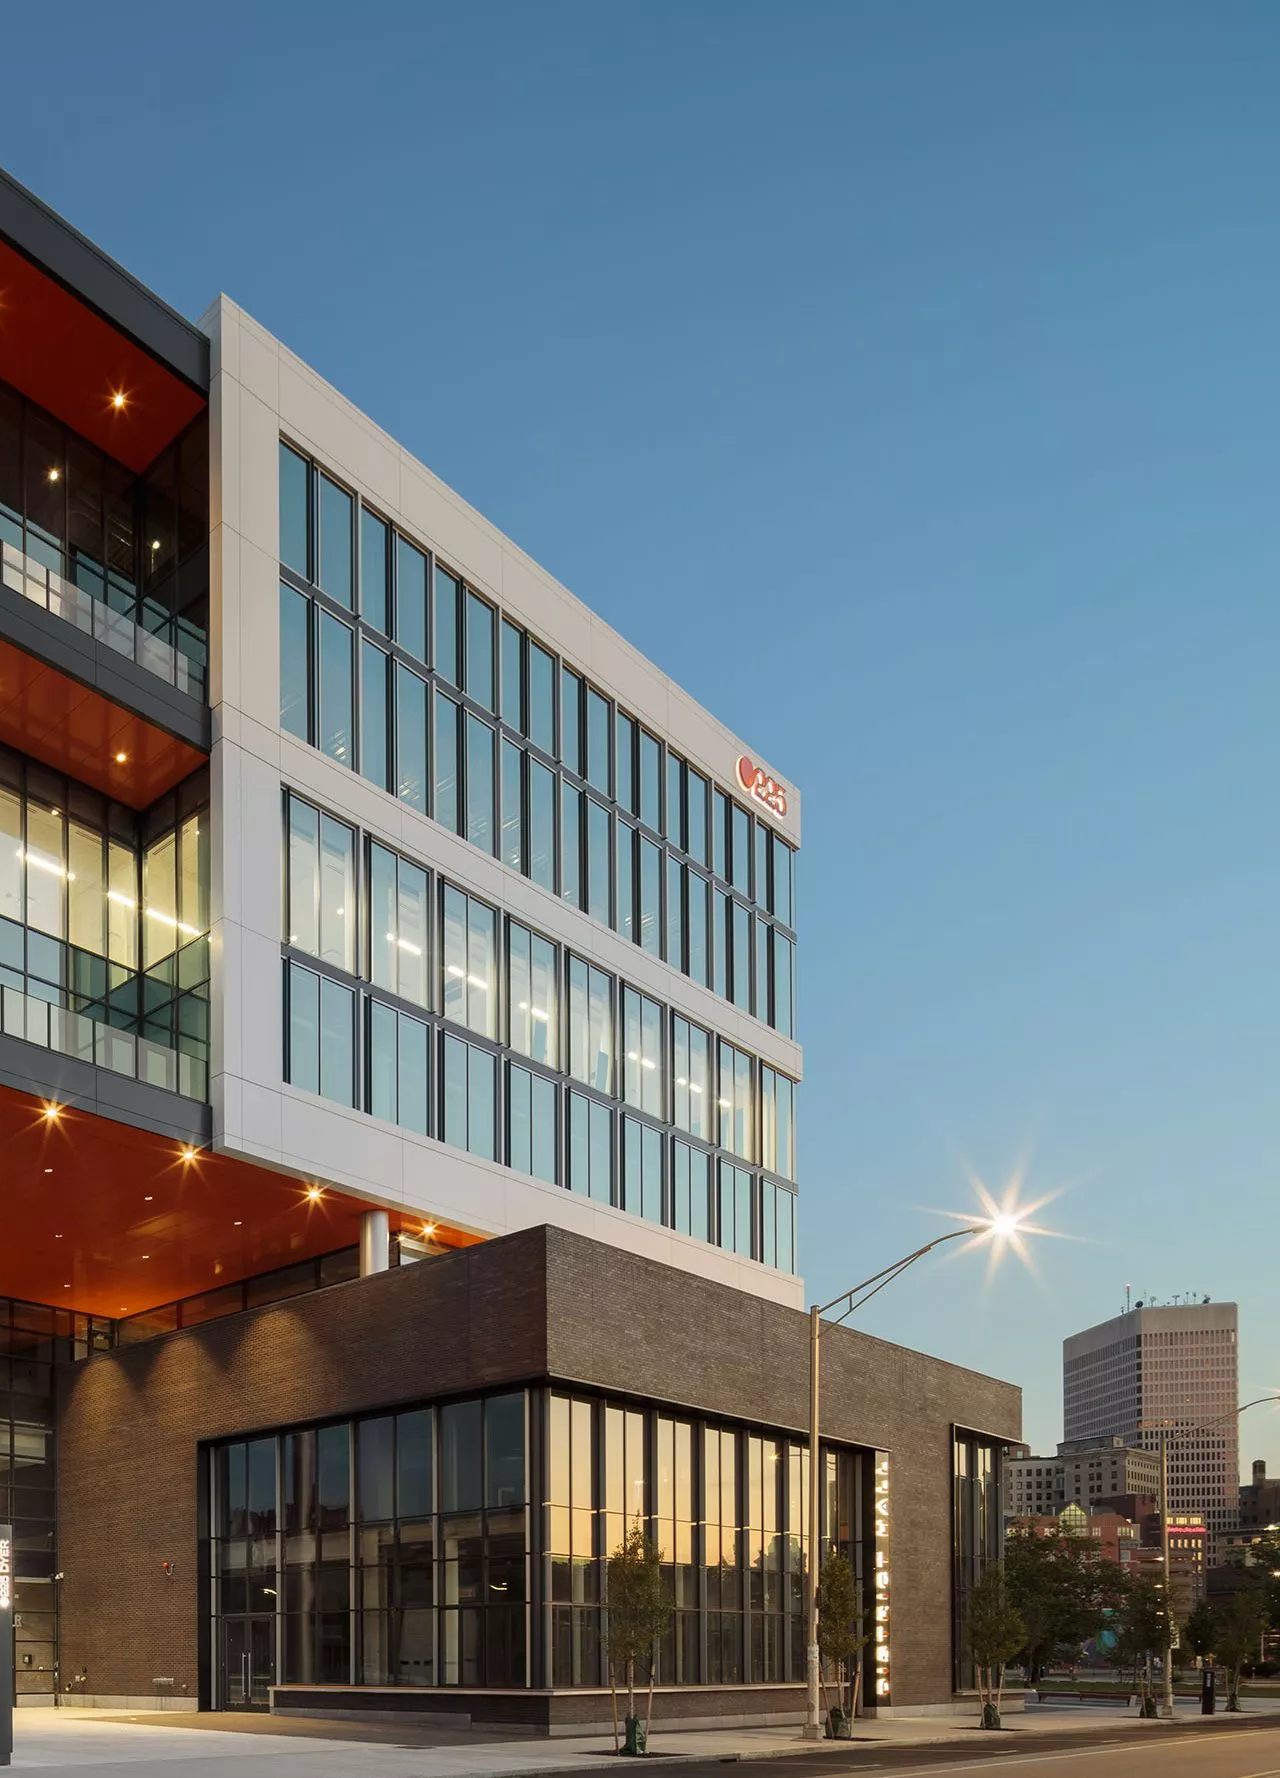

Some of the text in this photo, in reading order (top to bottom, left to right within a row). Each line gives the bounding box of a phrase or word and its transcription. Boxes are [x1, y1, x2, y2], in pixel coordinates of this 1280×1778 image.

[751, 768, 787, 818] 225
[0, 1539, 10, 1597] 225 DYER
[875, 1461, 890, 1696] DISTRICT HALL
